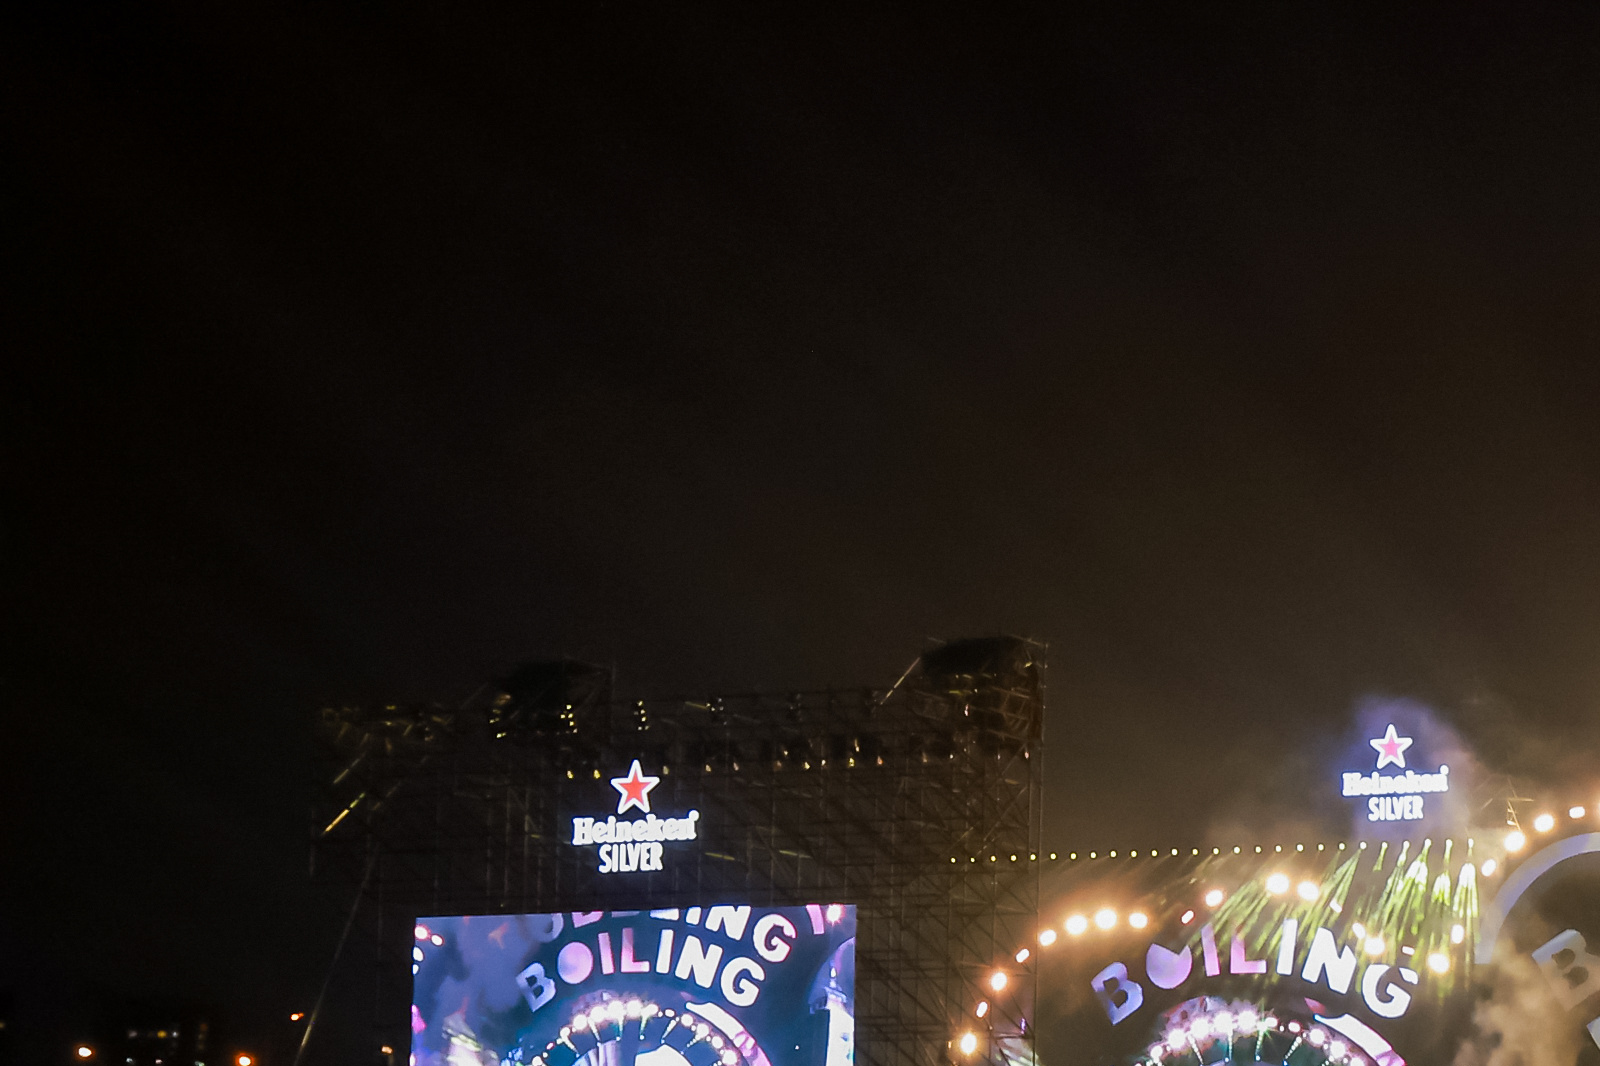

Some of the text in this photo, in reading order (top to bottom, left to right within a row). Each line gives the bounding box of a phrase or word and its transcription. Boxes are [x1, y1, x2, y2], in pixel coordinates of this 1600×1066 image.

[1368, 795, 1424, 822] SILVER
[572, 809, 700, 846] Heineken
[598, 842, 663, 873] SILVER
[515, 926, 766, 1014] BOILING
[1091, 918, 1419, 1026] BOILING
